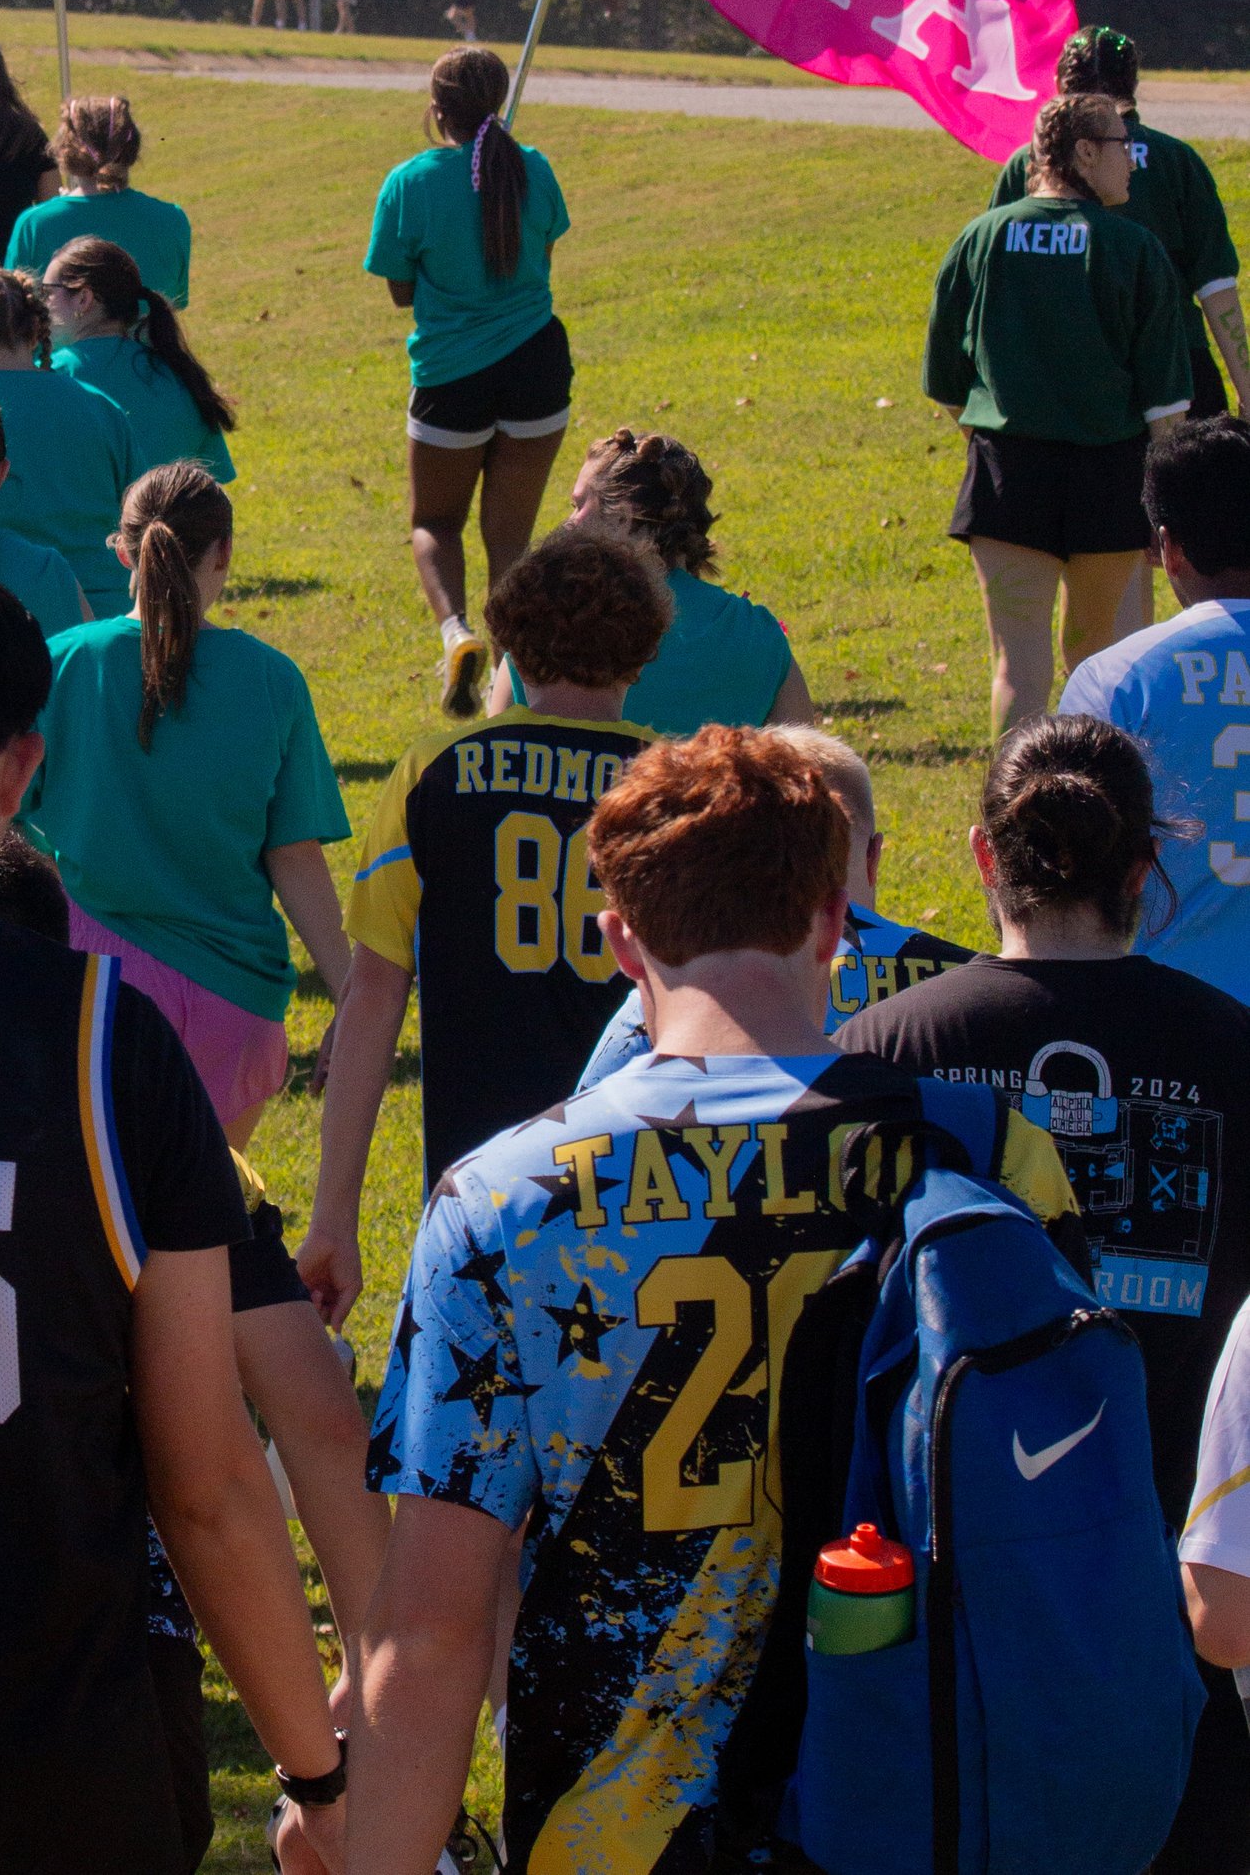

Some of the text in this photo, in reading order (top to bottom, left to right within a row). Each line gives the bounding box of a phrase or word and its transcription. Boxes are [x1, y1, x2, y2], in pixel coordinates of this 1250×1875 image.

[1005, 221, 1088, 255] IKERD
[933, 1067, 1201, 1105] SPRING 2024
[1051, 1096, 1092, 1110] ALPHA
[1061, 1108, 1084, 1121] TAU
[1095, 1270, 1203, 1312] ROOM
